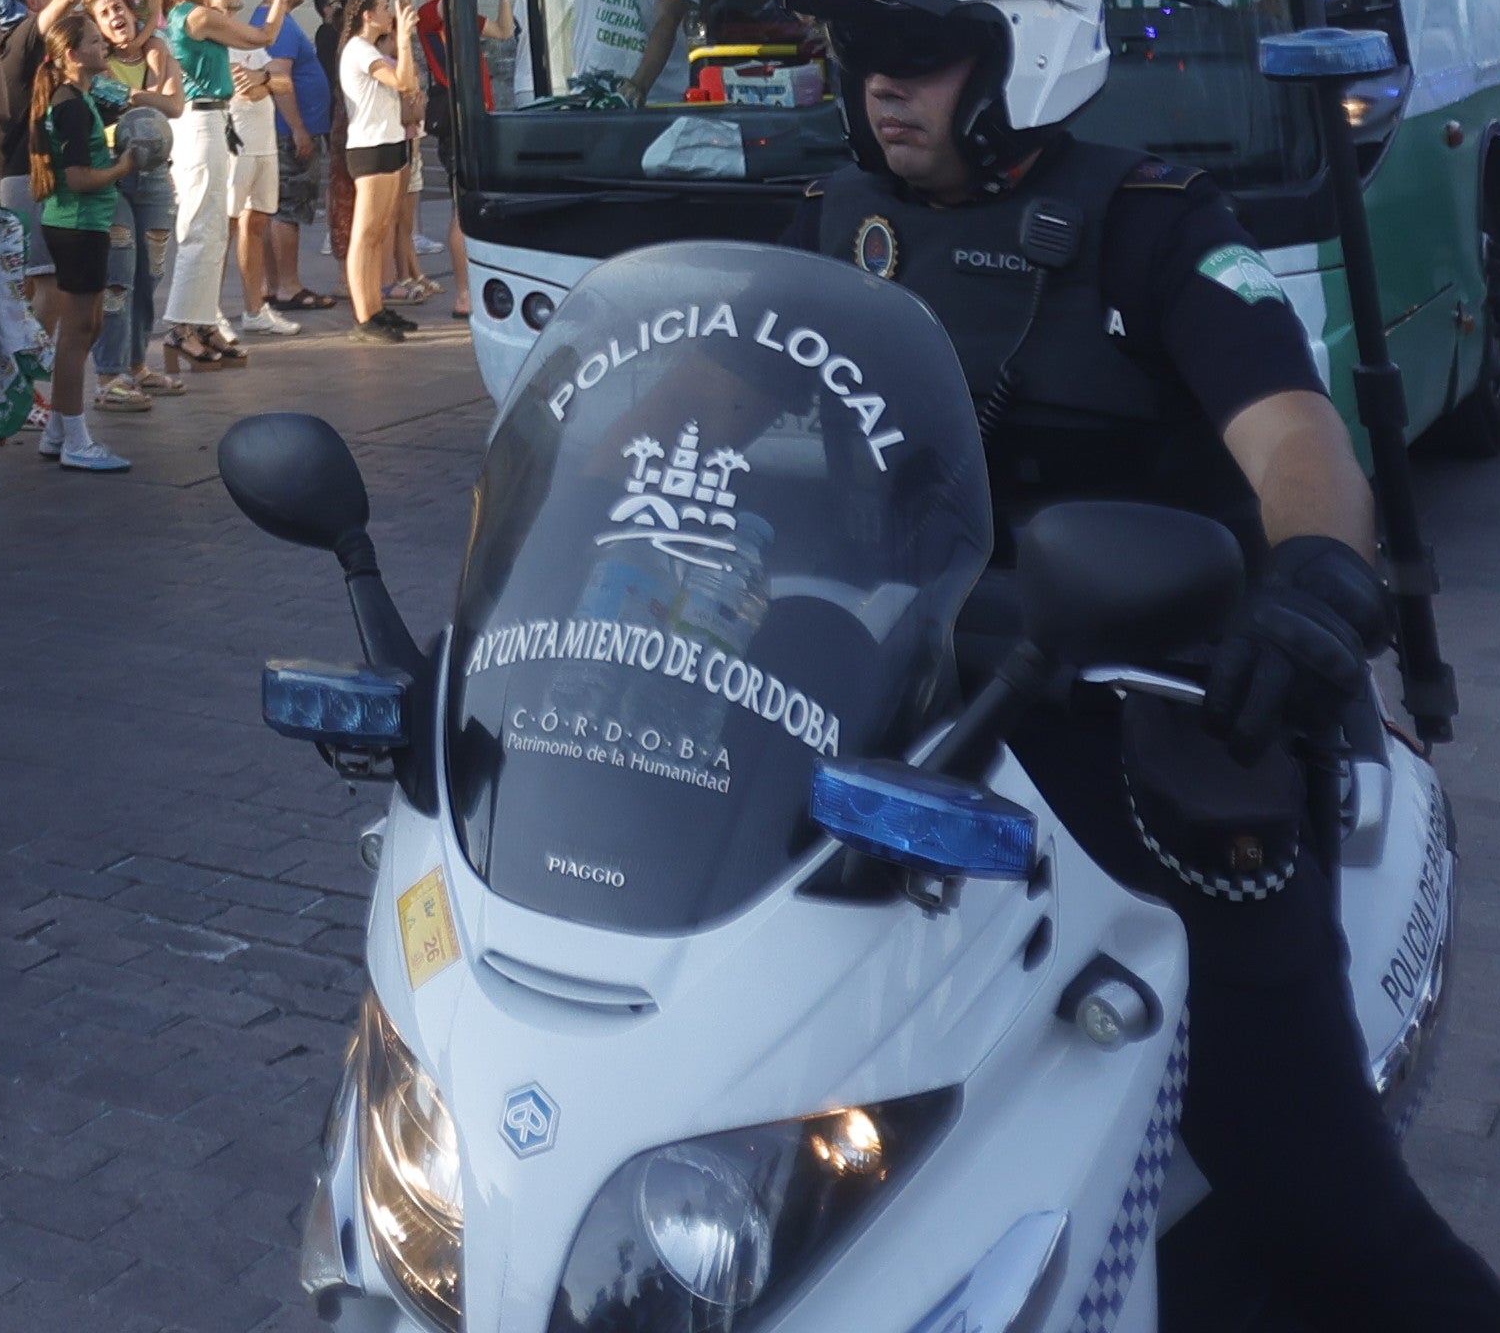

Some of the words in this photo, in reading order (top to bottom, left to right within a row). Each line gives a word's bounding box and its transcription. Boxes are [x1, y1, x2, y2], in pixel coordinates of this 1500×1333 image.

[596, 28, 647, 53] CREIMOS
[1106, 307, 1127, 337] A
[548, 303, 739, 422] POLICIA
[755, 309, 905, 472] LOCAL
[466, 620, 665, 677] AYUNTAMIENTO
[663, 635, 702, 684] DE
[704, 649, 841, 758] CORDOBA
[506, 733, 583, 760] Patrimonio
[587, 744, 607, 763] de
[611, 748, 625, 767] la
[630, 753, 731, 794] Humanidad
[548, 855, 626, 888] PIAGGIO
[1380, 902, 1435, 1018] POLICIA
